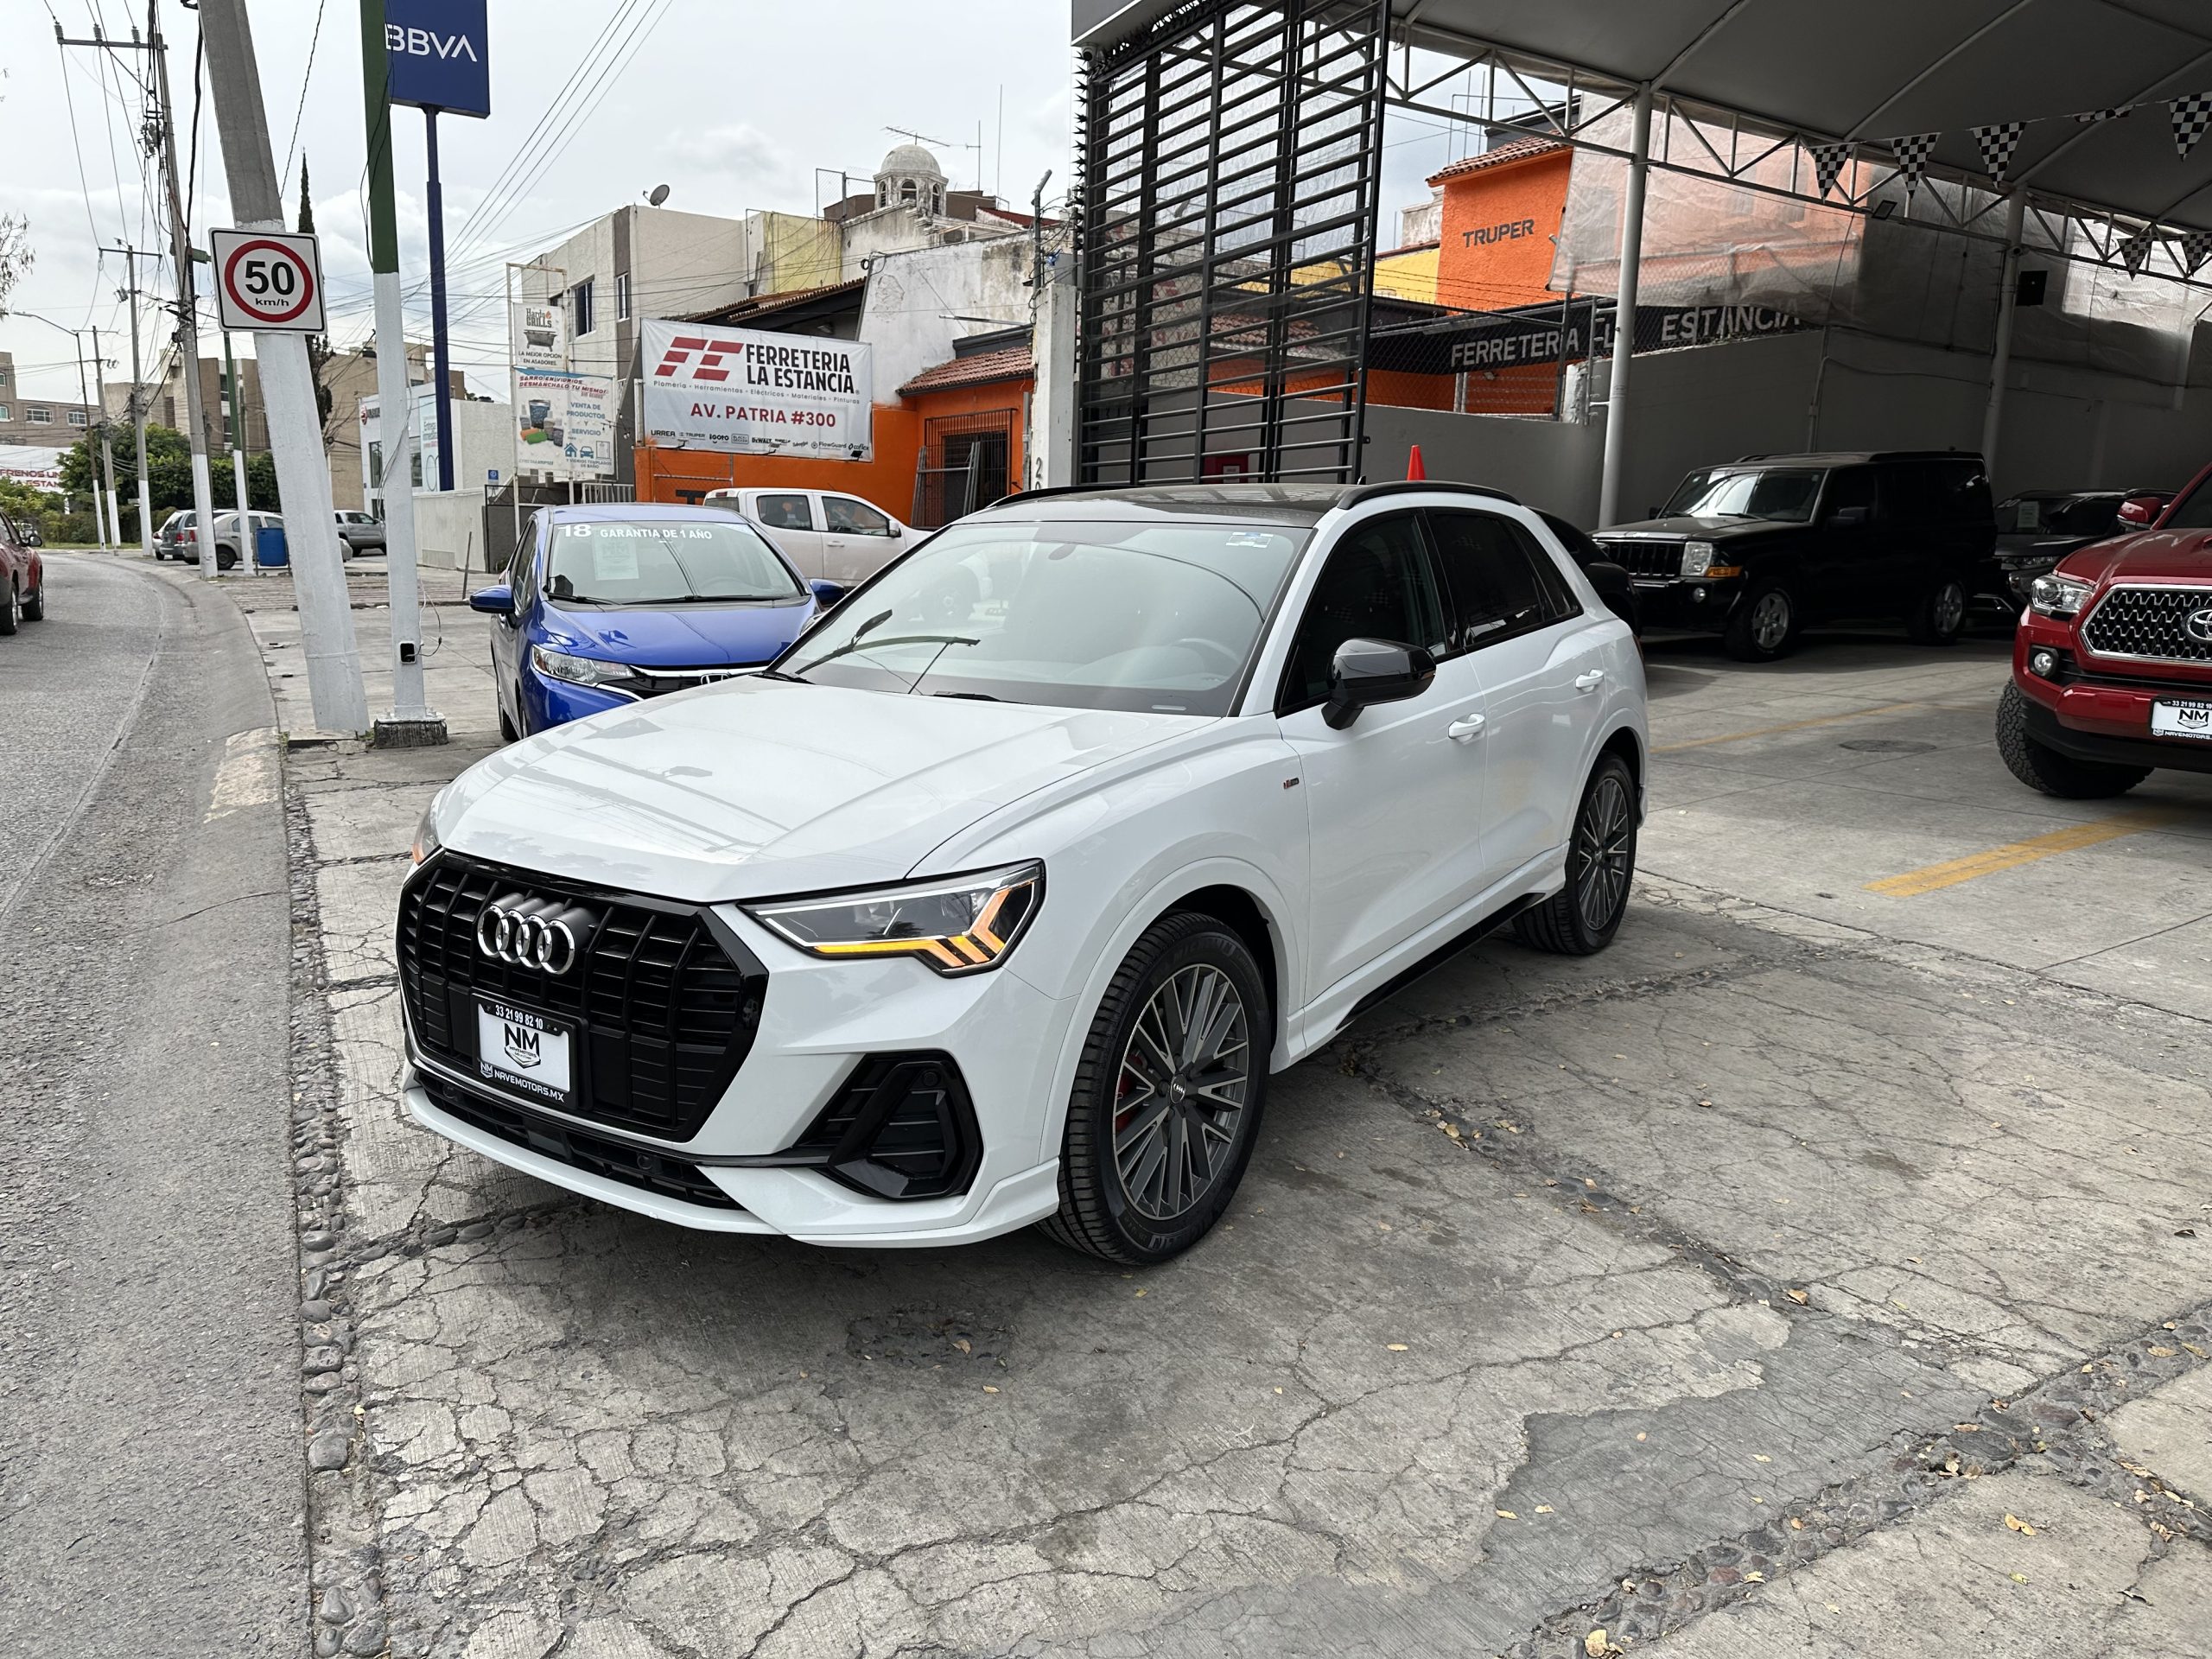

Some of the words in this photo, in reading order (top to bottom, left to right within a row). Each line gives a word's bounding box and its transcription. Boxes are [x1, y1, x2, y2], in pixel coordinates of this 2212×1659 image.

[385, 23, 477, 62] BBVA
[1462, 218, 1535, 248] TRUPER
[245, 260, 295, 296] 50
[254, 297, 289, 307] km/h
[526, 316, 552, 328] GRILLS
[747, 343, 851, 373] FERRETERIA
[1451, 327, 1580, 367] FERRETERIA
[747, 365, 769, 386] LA
[775, 367, 855, 394] ESTANCIA
[694, 385, 743, 394] Herramientas
[750, 389, 785, 397] Eléctricos
[791, 393, 827, 402] Materiales
[567, 410, 606, 419] PRODUCTOS
[690, 403, 721, 419] AV.
[725, 405, 787, 423] PATRIA
[791, 410, 836, 428] #300
[0, 469, 44, 478] FRENOS
[558, 524, 592, 537] 18
[600, 529, 660, 538] GARANTIA
[662, 529, 678, 538] DE
[681, 529, 686, 538] 1
[689, 528, 713, 540] AÑO
[2178, 709, 2209, 723] NM
[495, 1004, 504, 1017] 33
[505, 1007, 513, 1020] 21
[514, 1011, 523, 1023] 99
[524, 1014, 534, 1027] 82
[535, 1017, 543, 1030] 10
[504, 1022, 540, 1057] NM
[494, 1069, 564, 1103] NAVEMOTORS.MX
